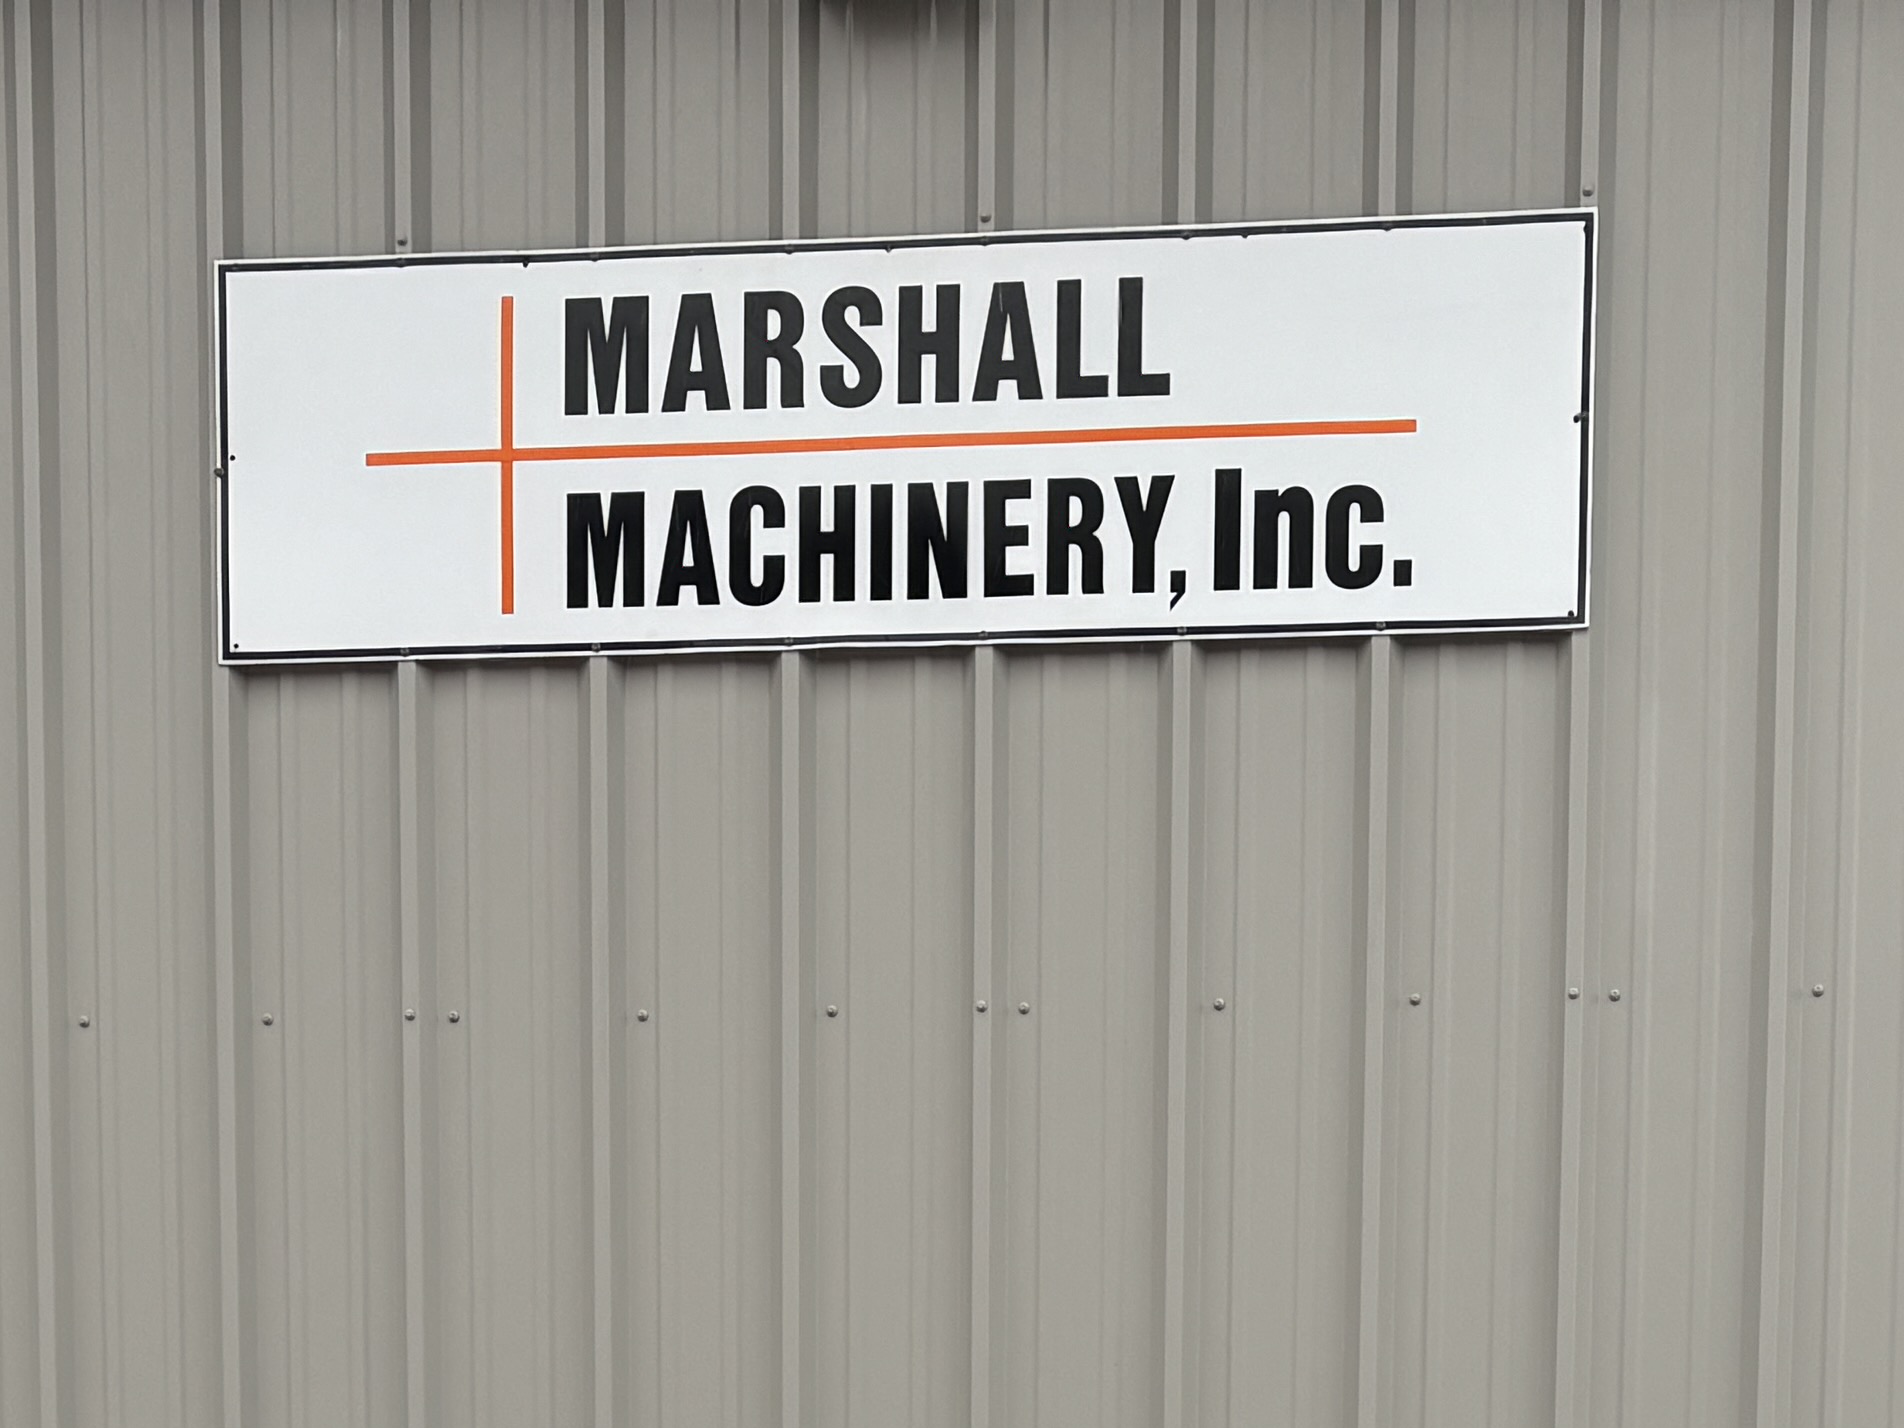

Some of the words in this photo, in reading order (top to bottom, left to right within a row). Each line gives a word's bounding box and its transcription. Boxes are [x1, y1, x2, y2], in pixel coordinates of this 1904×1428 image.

[564, 276, 1171, 416] MARSHALL
[566, 474, 1187, 612] MACHINERY,
[1213, 467, 1413, 591] Inc.
